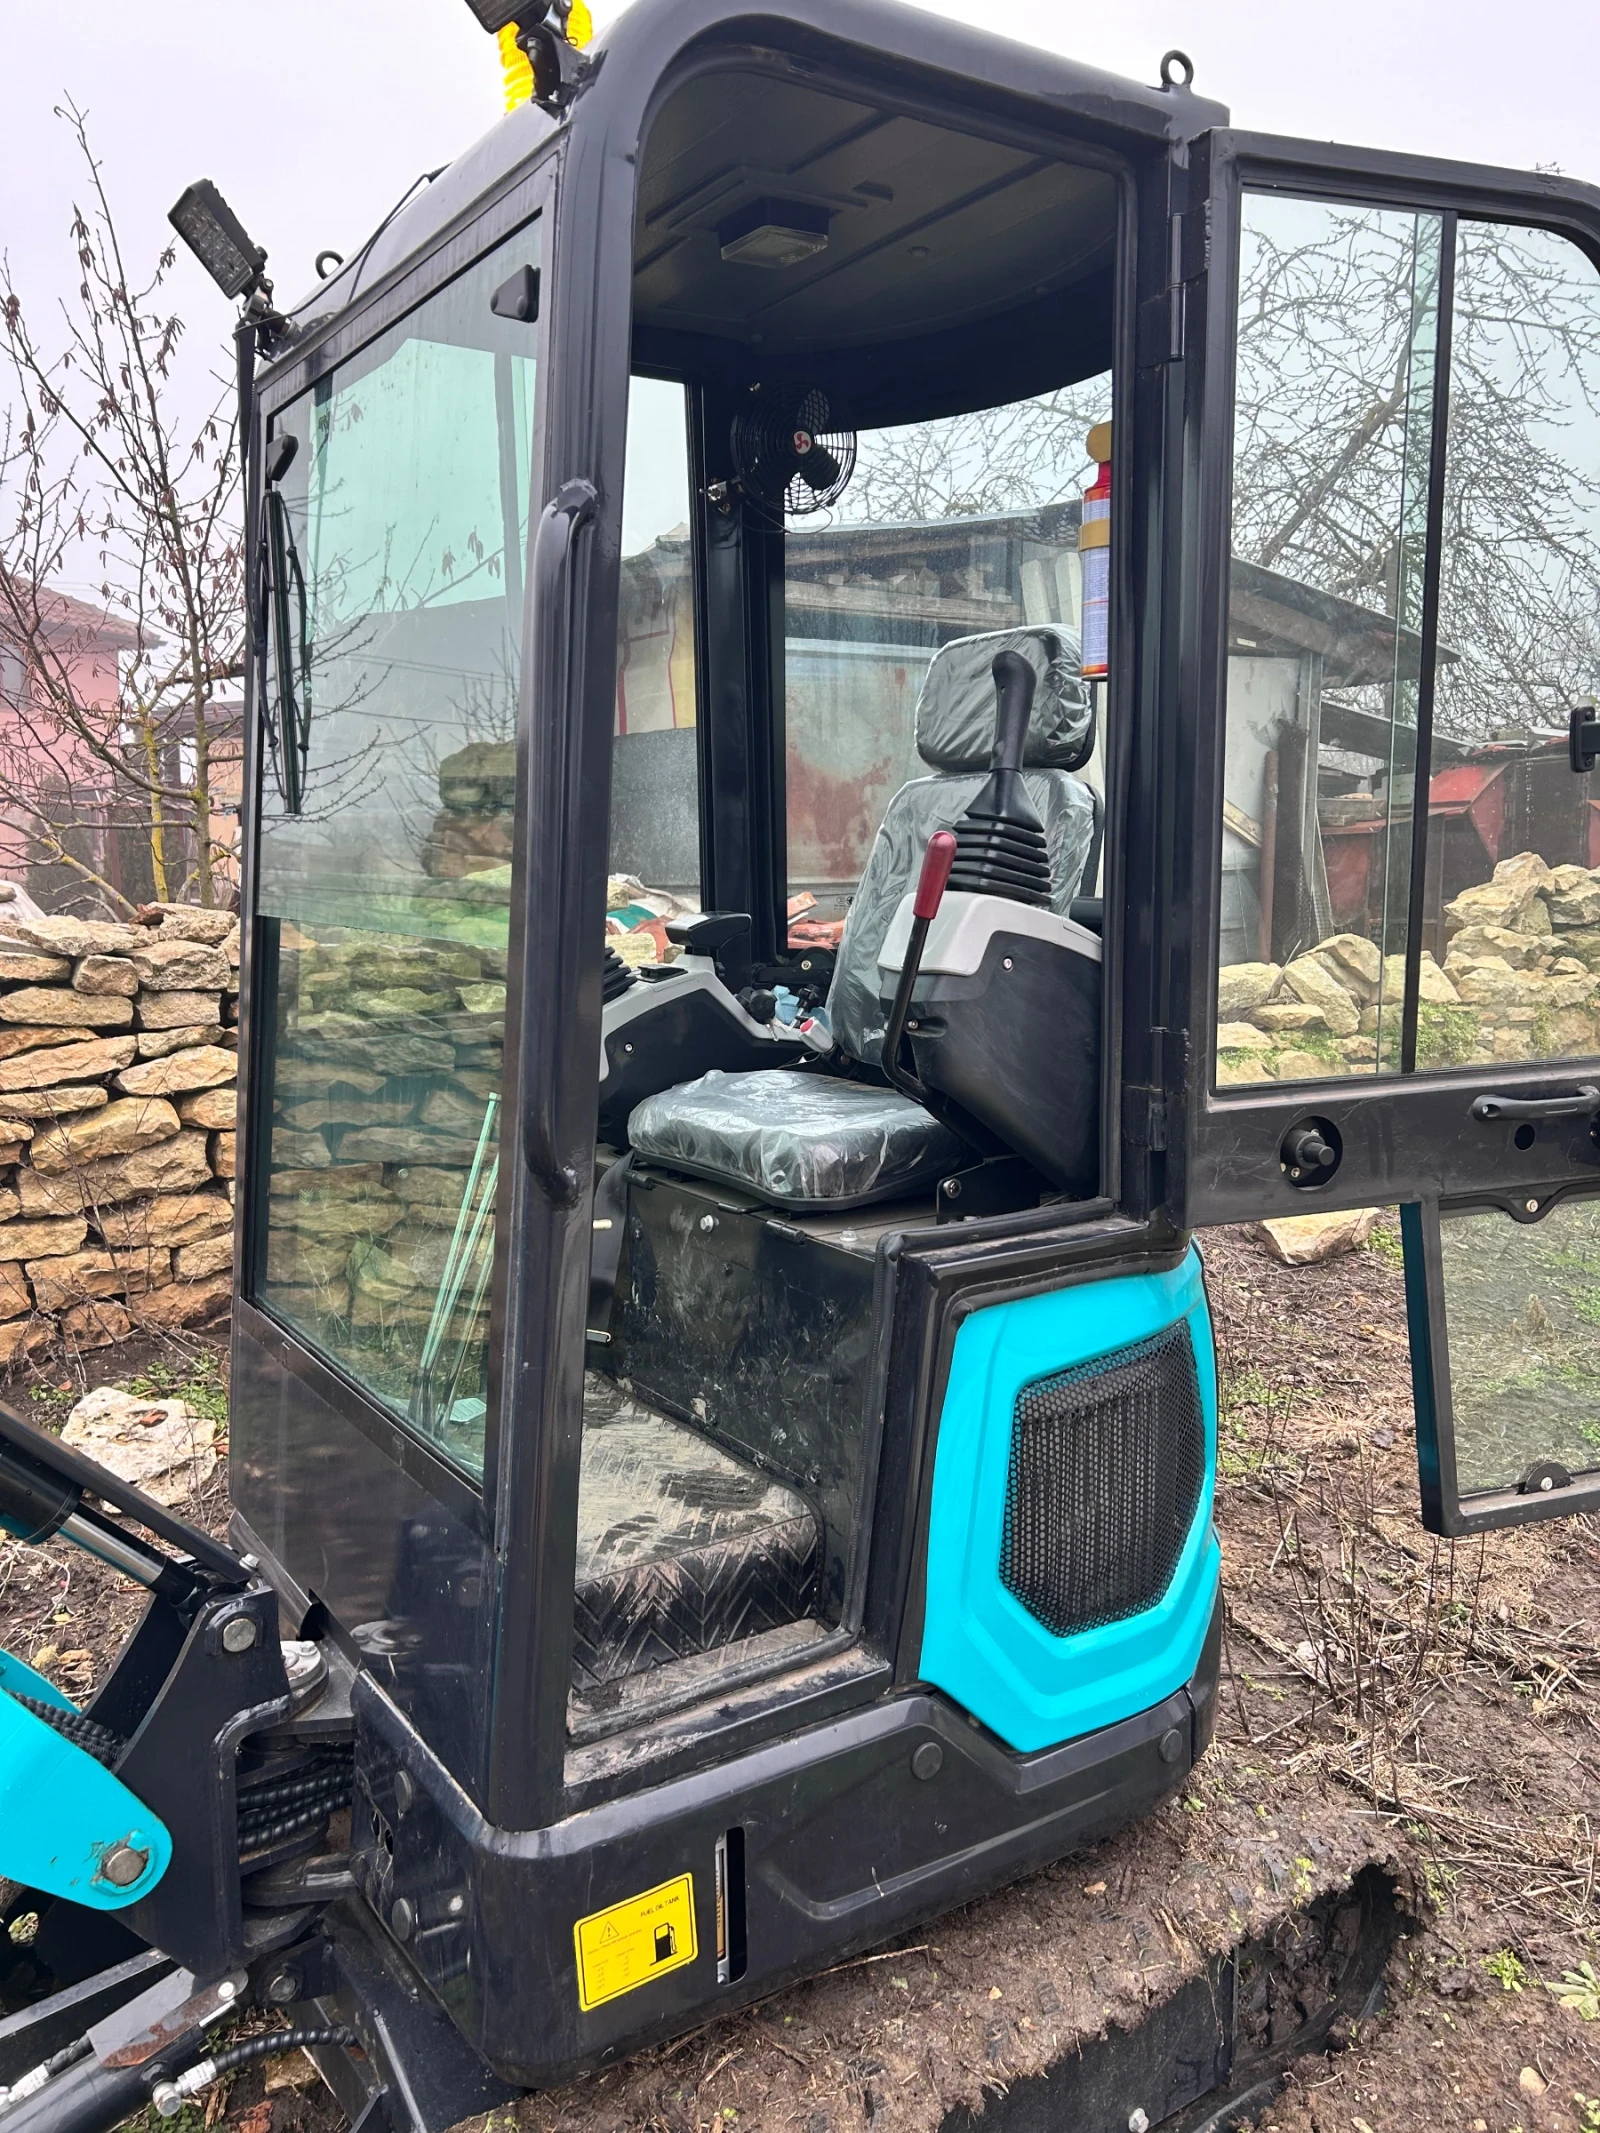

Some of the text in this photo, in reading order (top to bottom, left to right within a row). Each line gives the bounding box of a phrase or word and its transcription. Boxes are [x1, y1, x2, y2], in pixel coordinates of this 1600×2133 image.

[640, 1895, 680, 1917] FUEL OIL TANK
